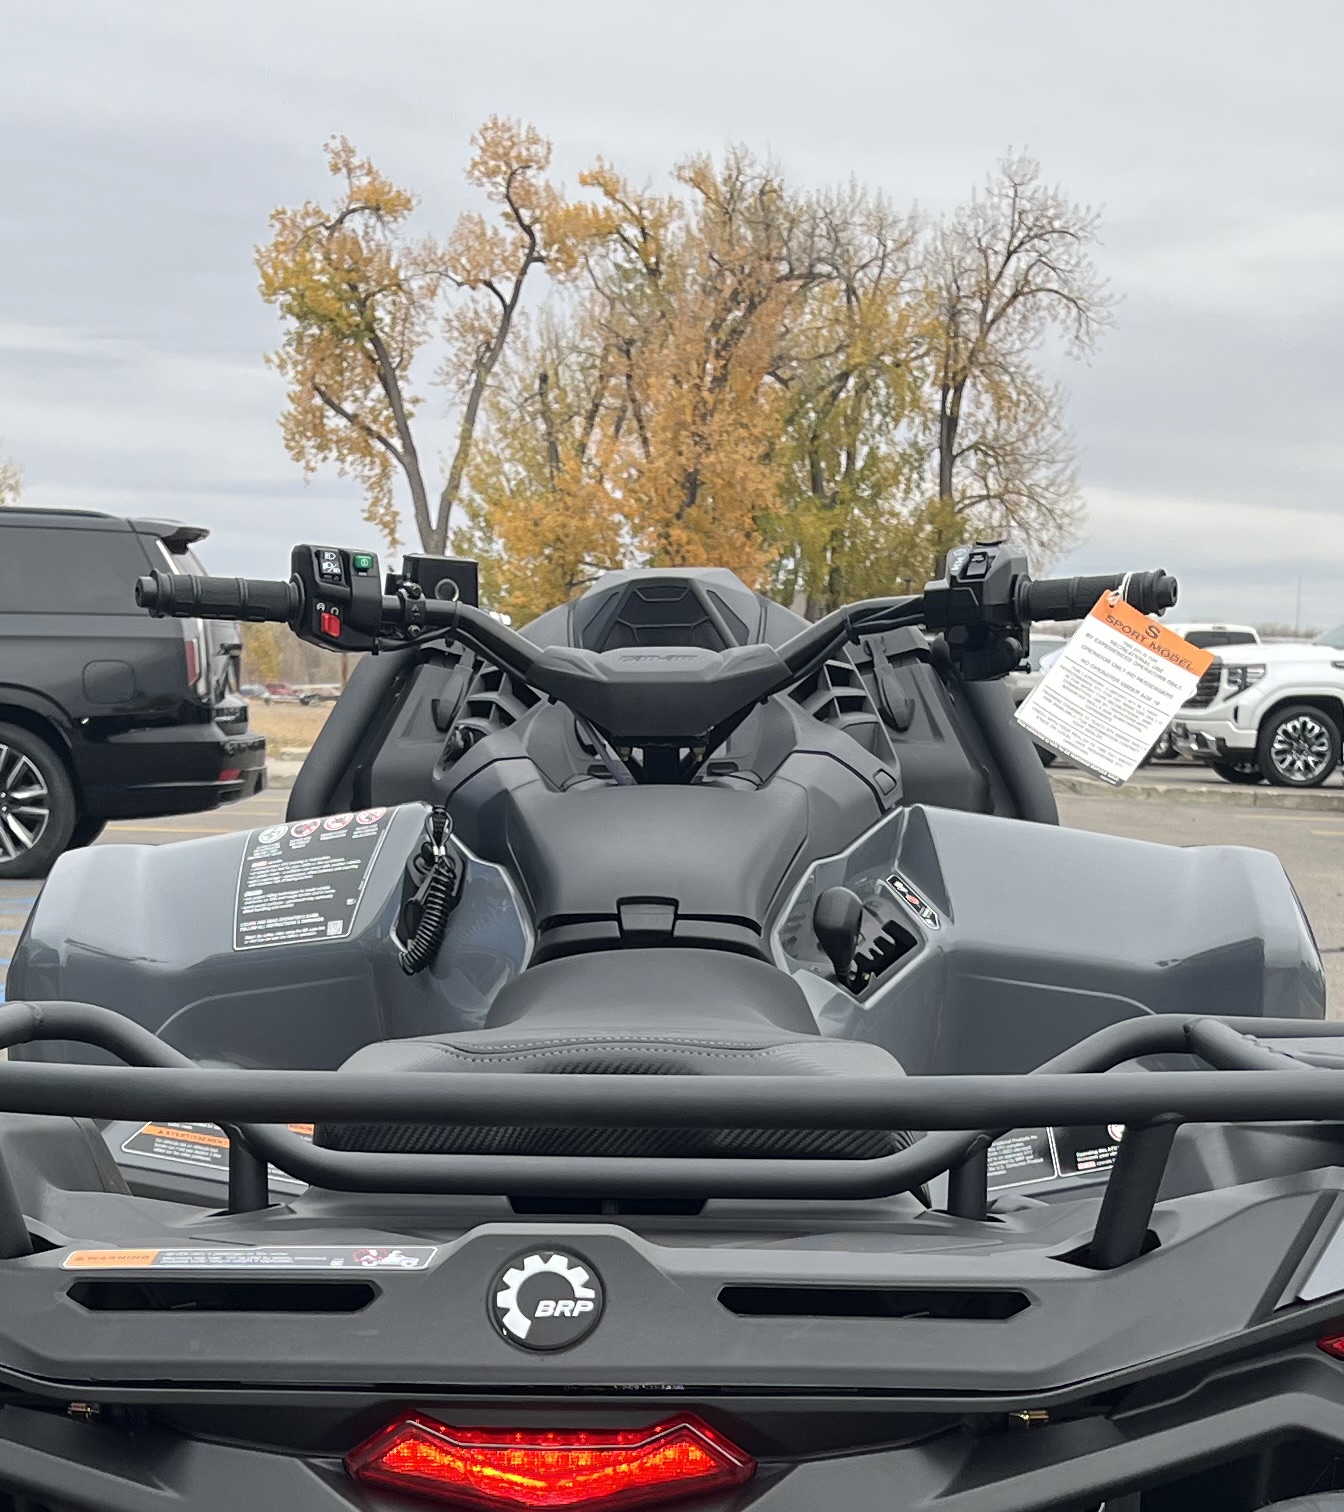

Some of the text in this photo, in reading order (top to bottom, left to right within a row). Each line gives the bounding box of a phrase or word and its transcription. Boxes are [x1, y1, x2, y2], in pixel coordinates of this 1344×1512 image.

[1144, 624, 1161, 640] S
[1105, 614, 1194, 672] SPORT MODEL
[535, 1300, 594, 1318] BRP
